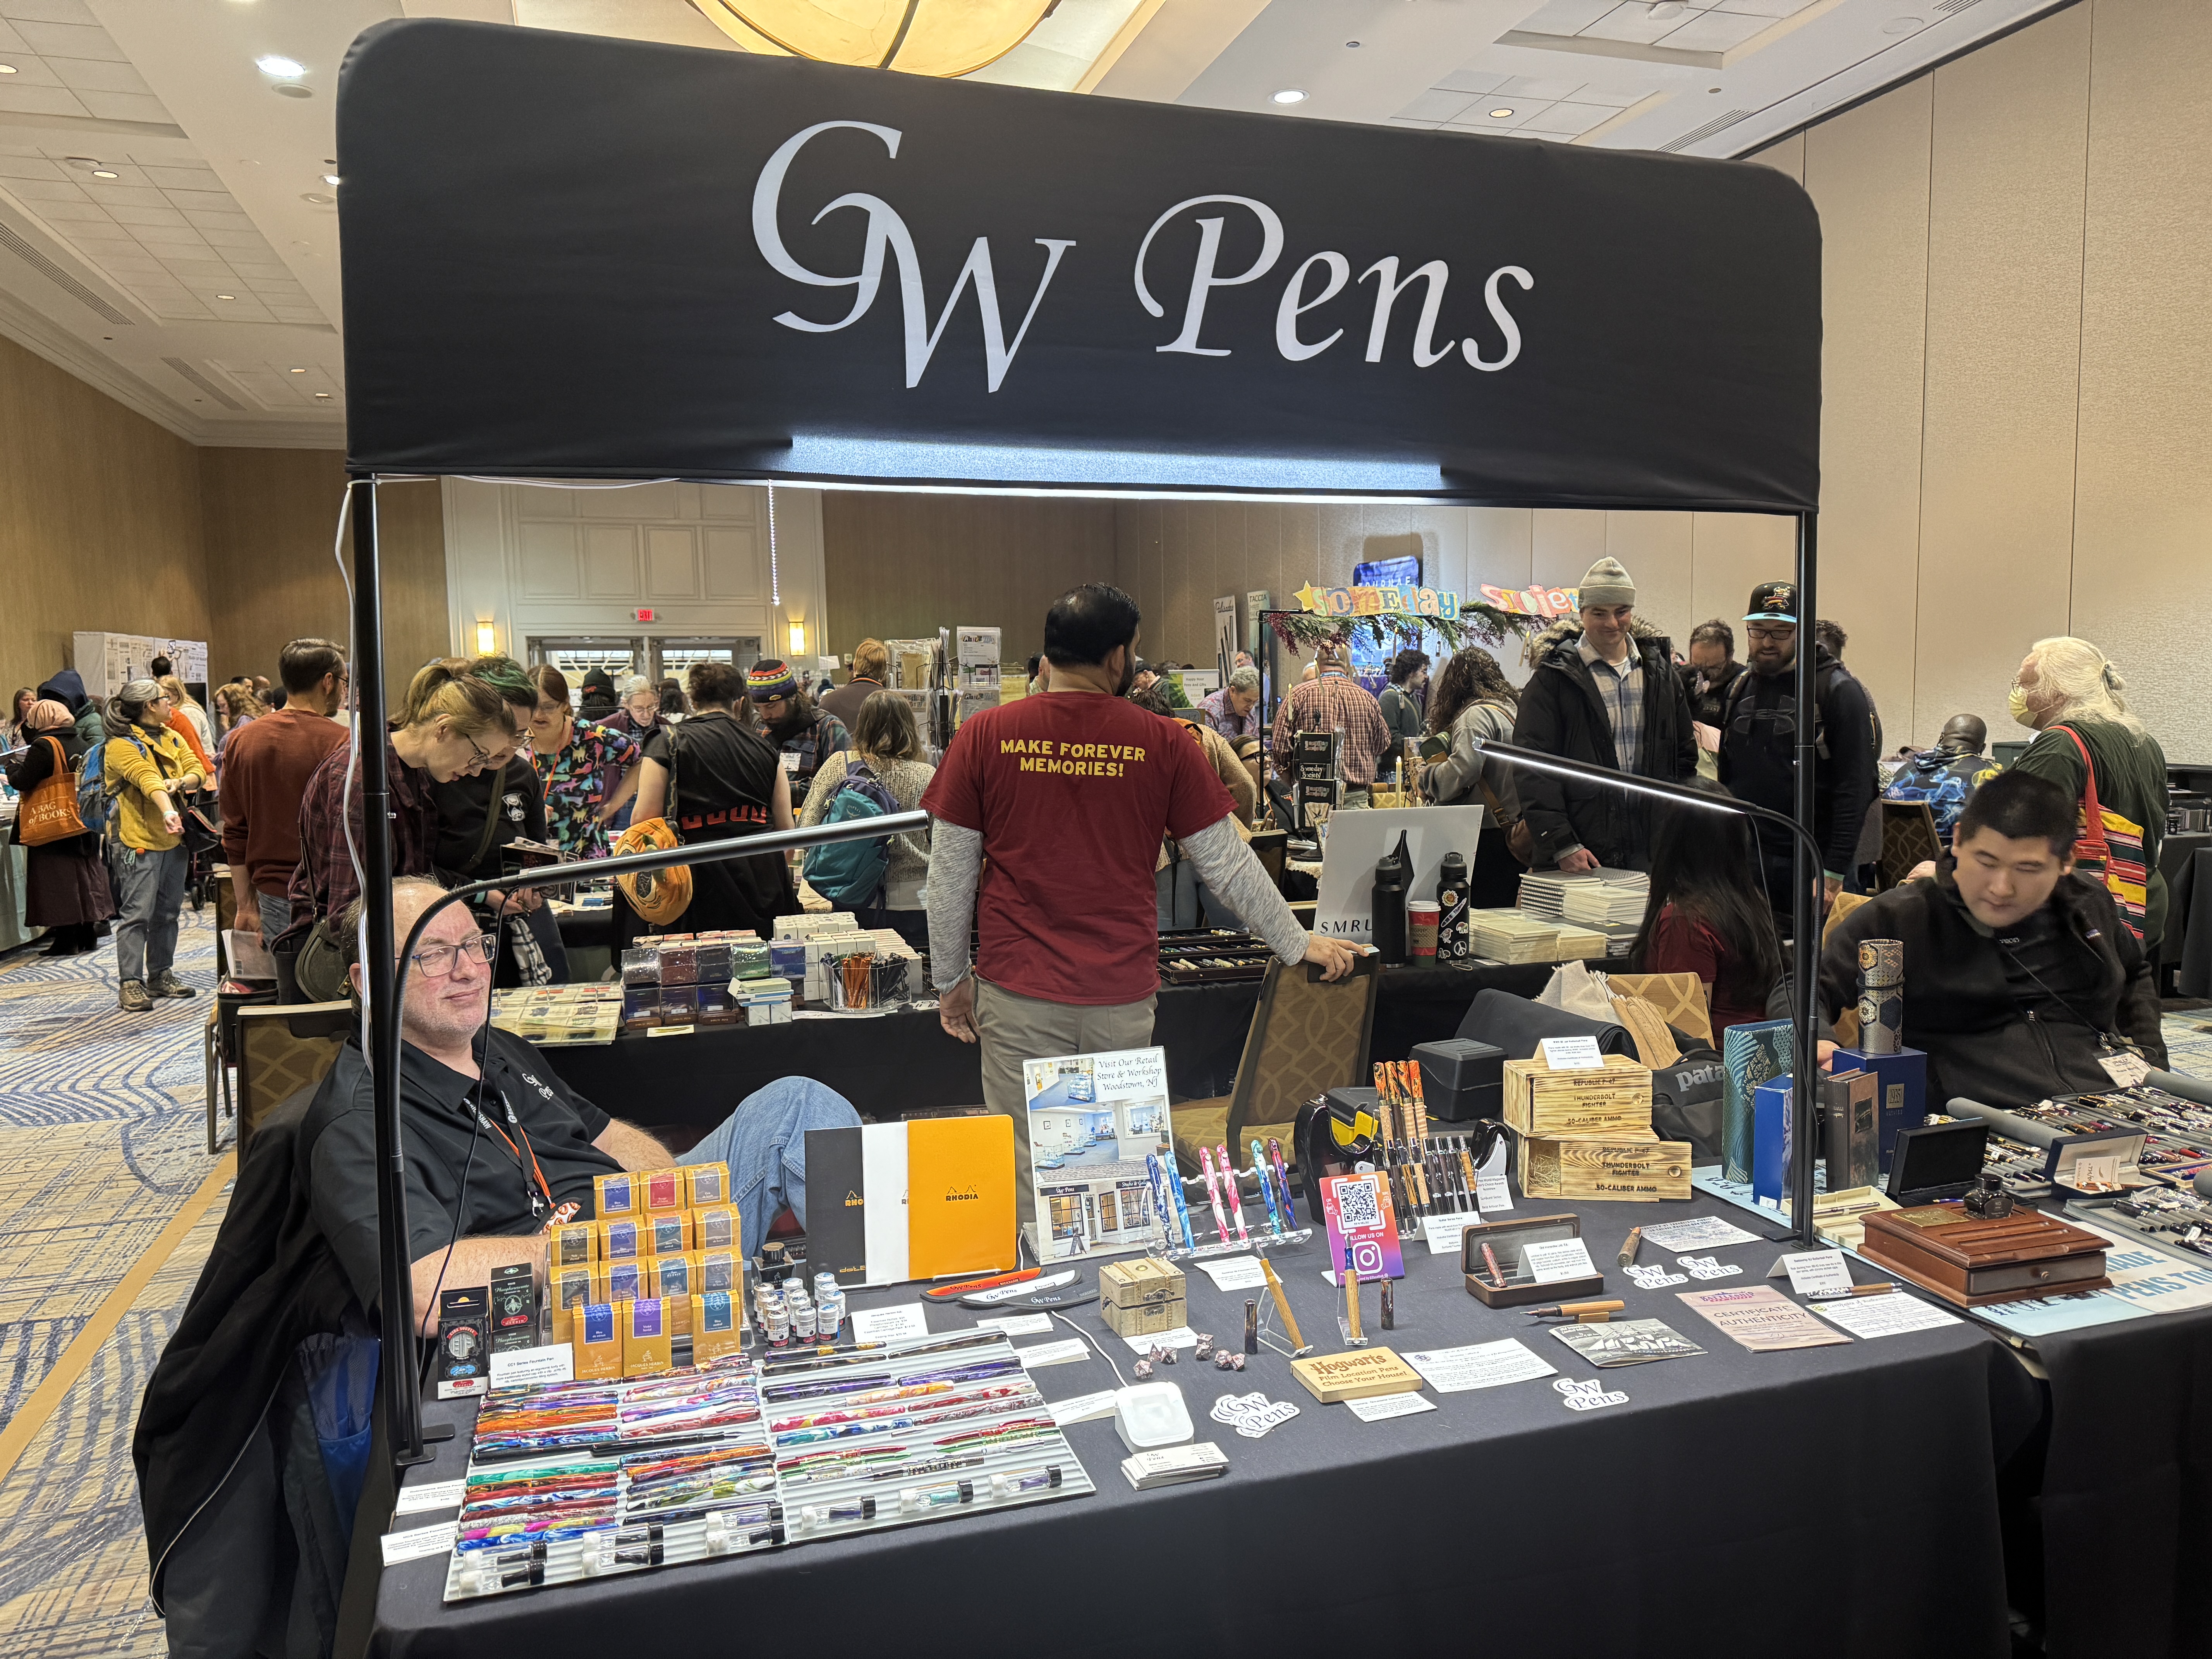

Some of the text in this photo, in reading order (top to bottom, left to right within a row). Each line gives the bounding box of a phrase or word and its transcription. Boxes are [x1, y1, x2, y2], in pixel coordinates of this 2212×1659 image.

[752, 120, 1534, 393] GW Pens
[1250, 594, 1267, 602] TACCIA
[638, 609, 652, 621] EXIT
[1001, 739, 1145, 761] MAKE FOREVER
[1020, 757, 1123, 777] MEMORIES!
[38, 801, 56, 813] BAG
[29, 808, 72, 825] of BOOKS
[1099, 1060, 1116, 1068] Visit
[1135, 1053, 1159, 1065] Retail
[1097, 1072, 1115, 1080] Store
[1127, 1066, 1161, 1077] Workshop
[1103, 1077, 1158, 1091] Woodstown, NJ
[1595, 1184, 1634, 1192] .50-CALIBER
[1680, 1258, 1716, 1268] GW
[1626, 1266, 1662, 1277] GW
[1692, 1265, 1740, 1278] Pens
[1637, 1274, 1685, 1288] Pens
[2114, 1277, 2186, 1300] PENS
[1714, 1306, 1793, 1317] CERTIFICATE
[1720, 1312, 1809, 1326] AUTHENTICITY
[1309, 1355, 1387, 1374] Hogwarts
[1377, 1371, 1407, 1379] House!
[1557, 1380, 1598, 1395] GW
[1568, 1393, 1625, 1408] Pens
[1246, 1405, 1296, 1428] Pens
